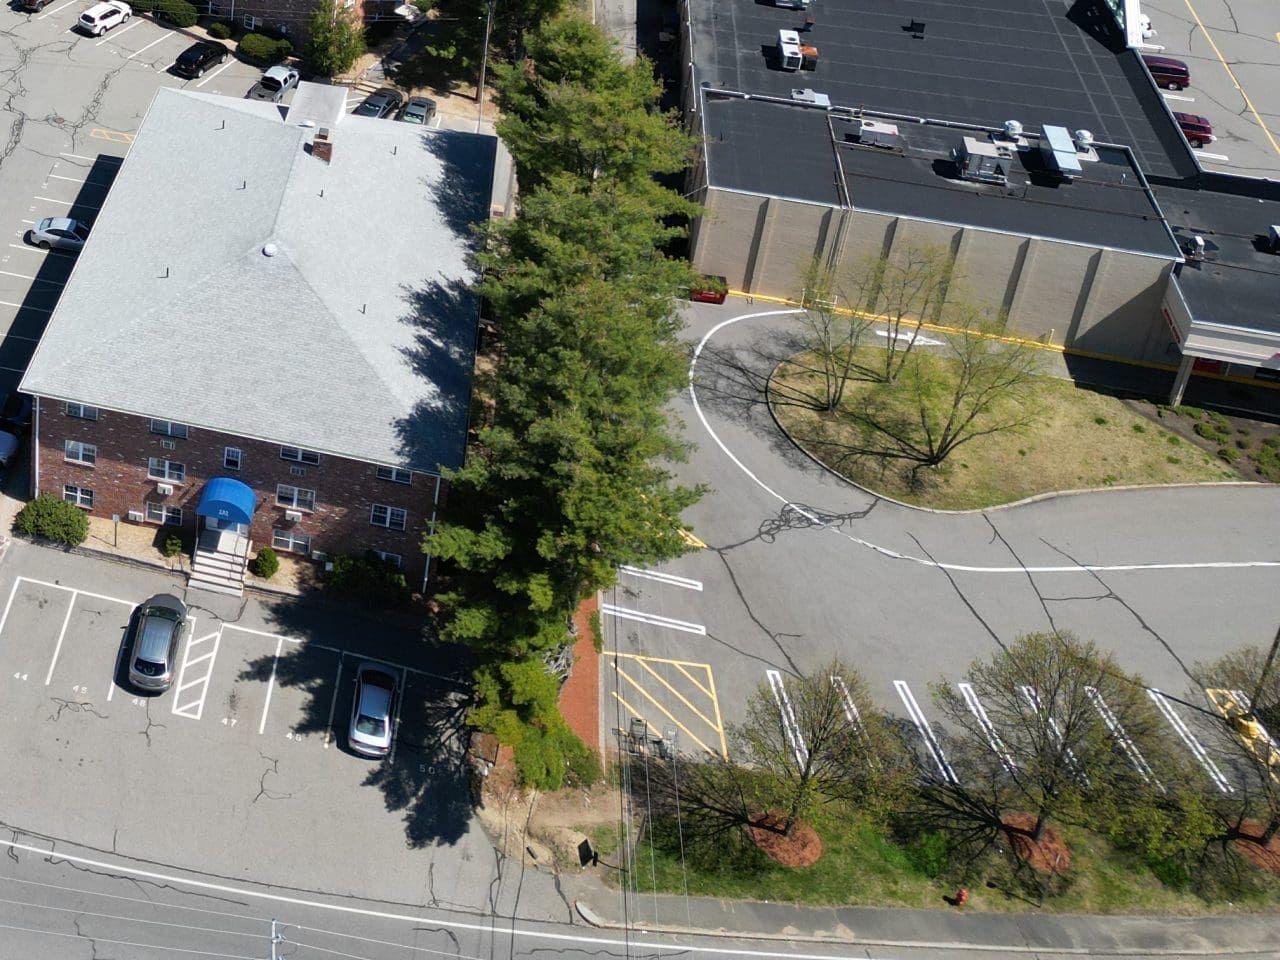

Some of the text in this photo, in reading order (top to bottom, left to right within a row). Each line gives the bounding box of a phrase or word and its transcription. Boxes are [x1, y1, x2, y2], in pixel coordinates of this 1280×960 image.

[14, 672, 28, 681] 44
[73, 685, 88, 694] 45
[221, 718, 238, 727] 47
[419, 764, 435, 775] 50
